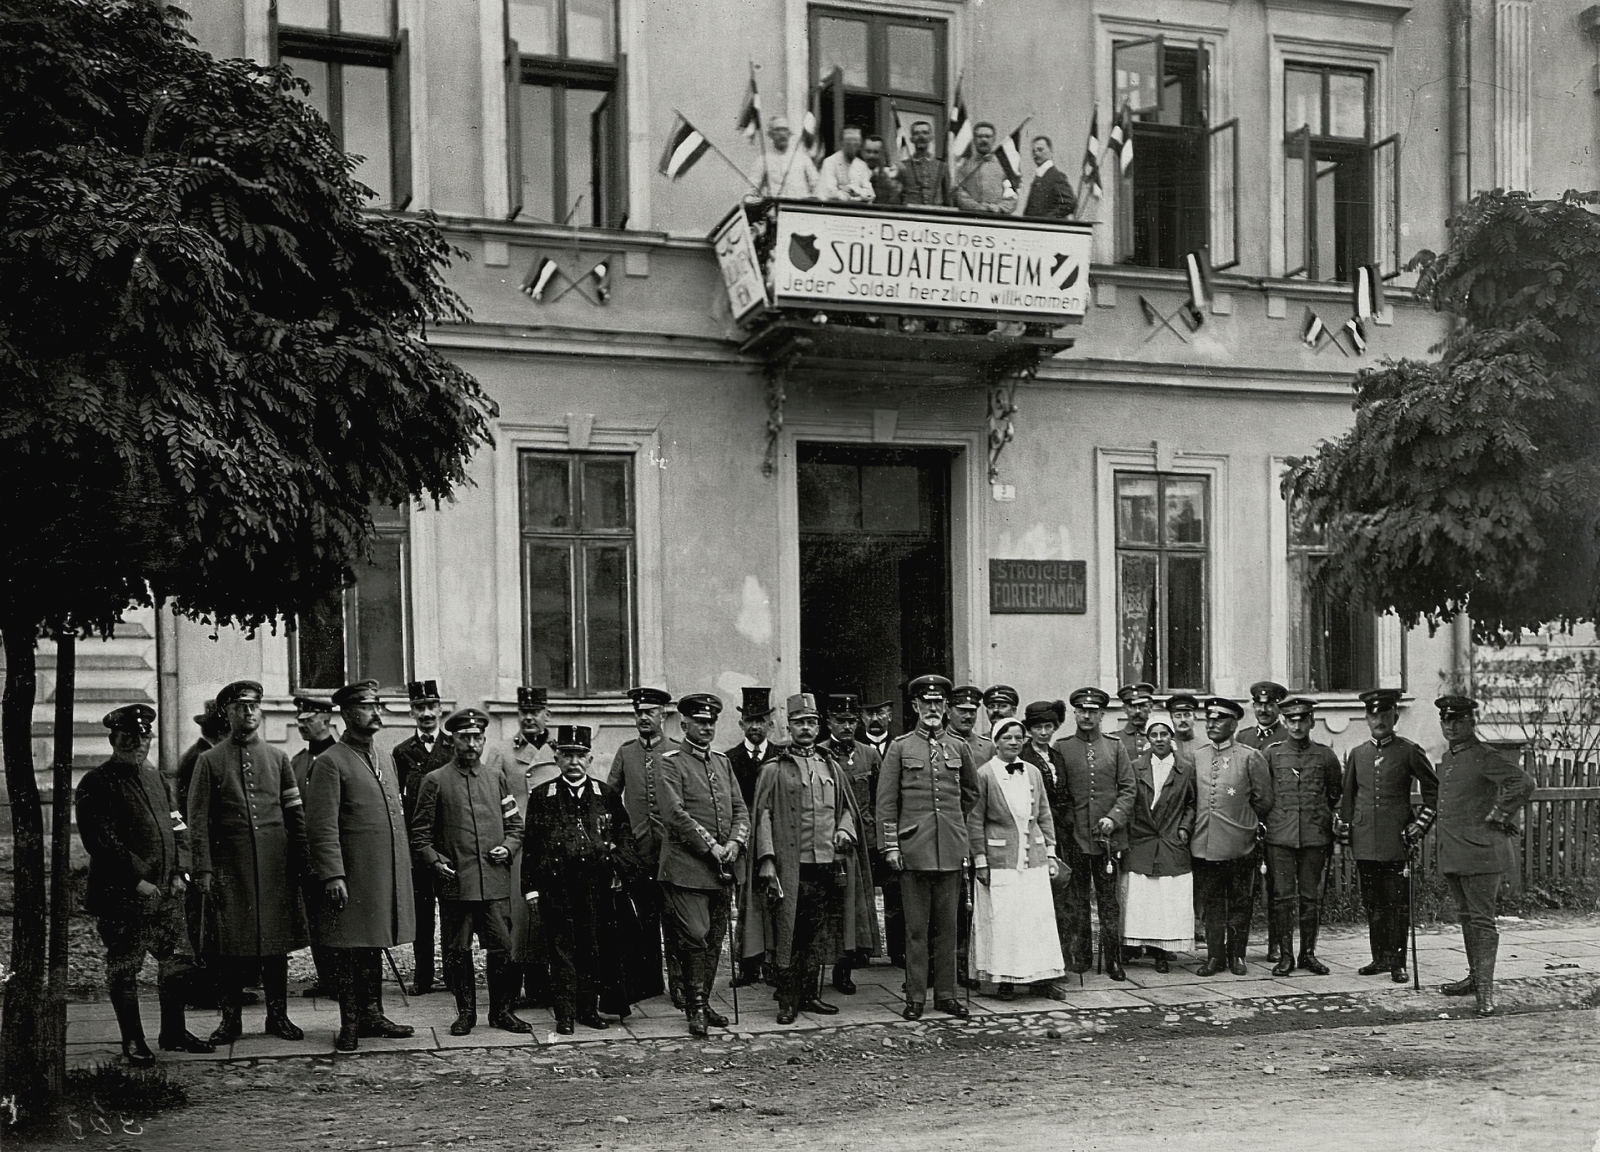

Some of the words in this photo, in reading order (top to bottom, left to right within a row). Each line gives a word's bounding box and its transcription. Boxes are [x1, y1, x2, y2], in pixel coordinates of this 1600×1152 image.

[881, 223, 996, 249] Deutsches
[829, 240, 1042, 287] SOLDATENHEIM
[783, 274, 836, 293] Jeder
[847, 276, 900, 298] Soldat
[909, 281, 979, 303] herzlich
[990, 289, 1081, 310] willkommen
